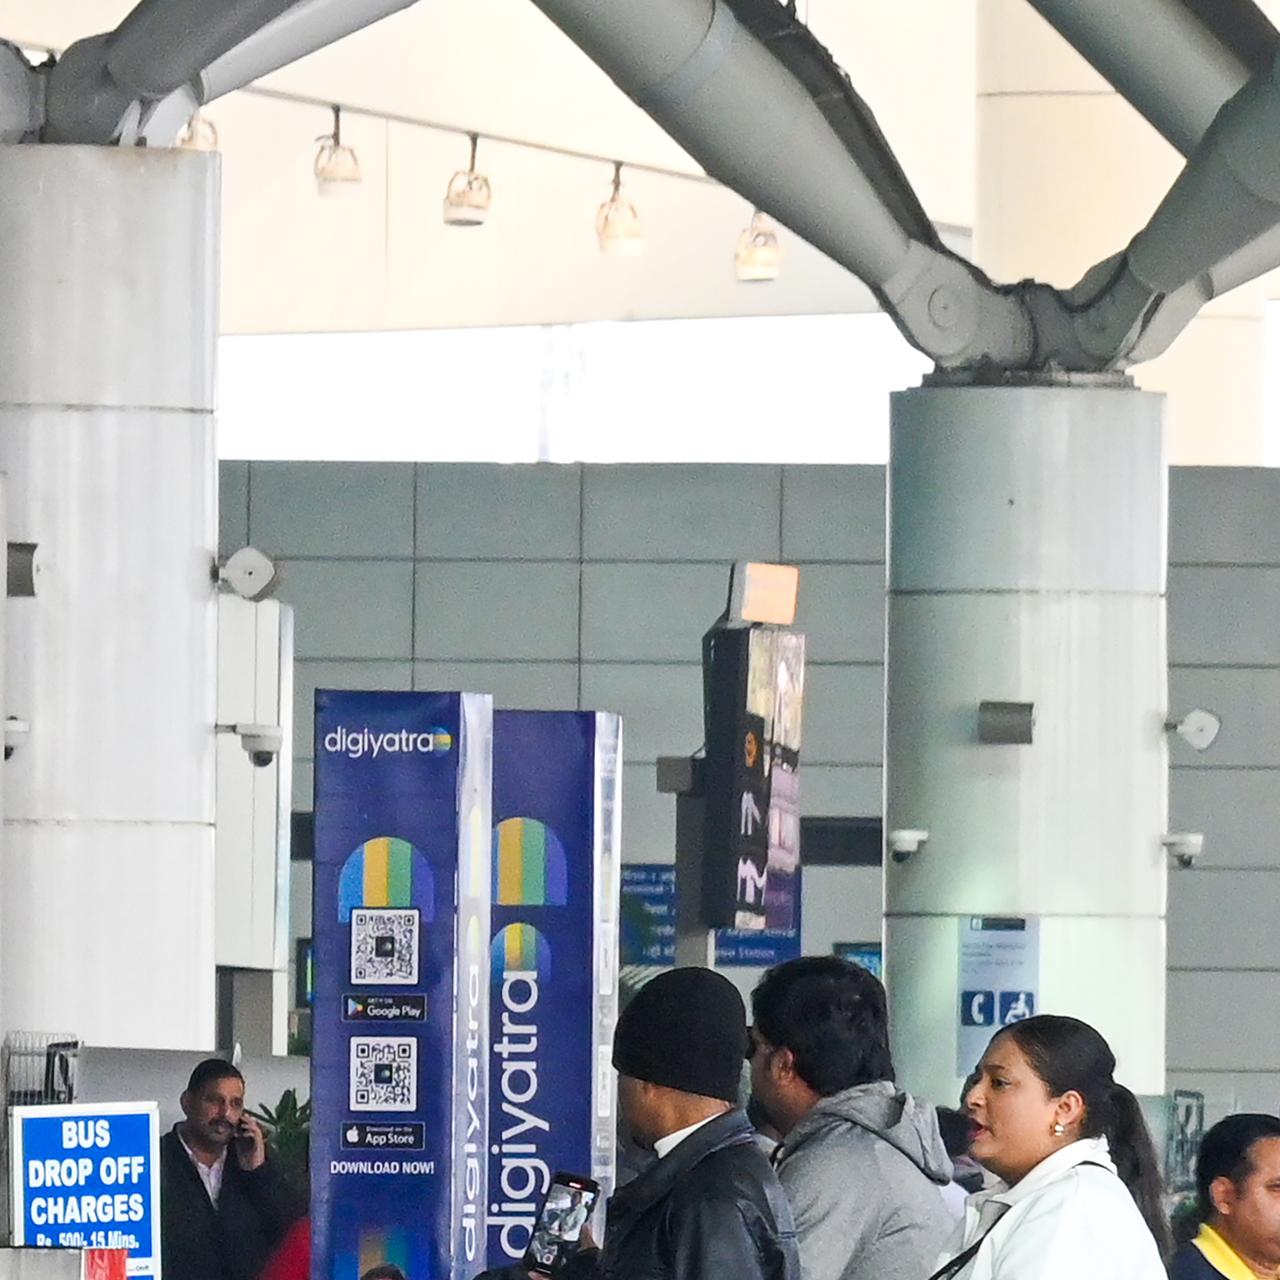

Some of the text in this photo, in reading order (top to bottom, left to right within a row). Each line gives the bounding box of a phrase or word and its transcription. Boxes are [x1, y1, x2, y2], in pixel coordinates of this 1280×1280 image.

[324, 725, 436, 758] digiyatra
[367, 1005, 421, 1019] Google Play
[487, 970, 550, 1259] digiyatra
[62, 1119, 111, 1149] BUS
[365, 1133, 414, 1146] App Store
[28, 1156, 145, 1188] DROP OFF
[330, 1161, 435, 1175] DOWNLOAD NOW!
[31, 1193, 144, 1225] CHARGES
